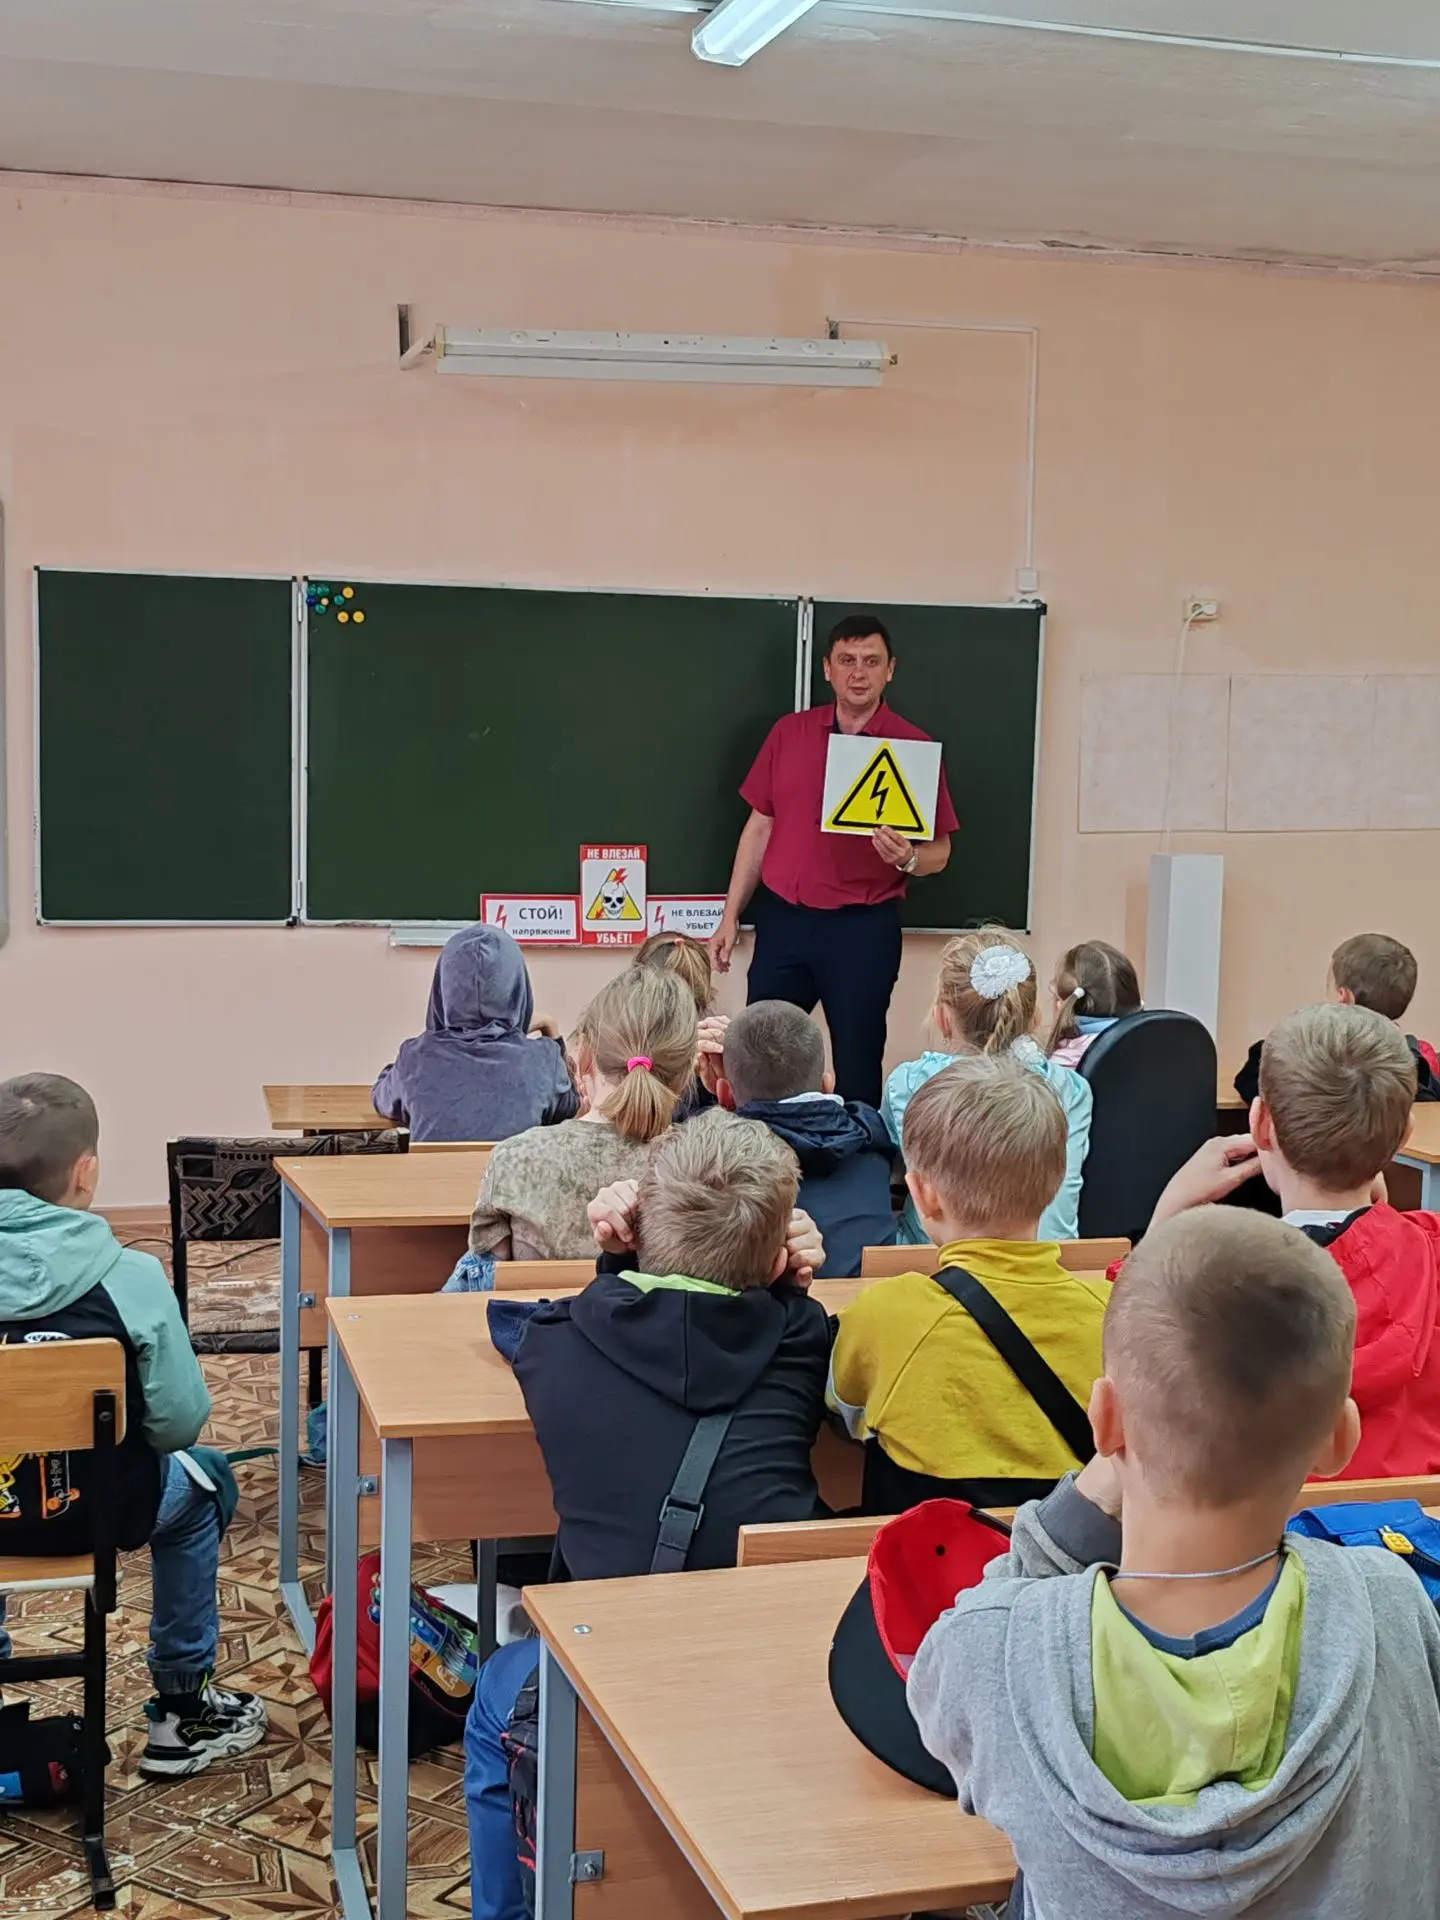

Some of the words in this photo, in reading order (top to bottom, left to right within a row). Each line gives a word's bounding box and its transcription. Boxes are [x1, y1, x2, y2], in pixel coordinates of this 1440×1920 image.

[587, 848, 600, 859] НЕ
[602, 847, 641, 859] ВЛЕЗАЙ
[518, 905, 563, 920] СТОЙ!
[671, 909, 684, 917] НЕ
[512, 928, 572, 937] напряжение
